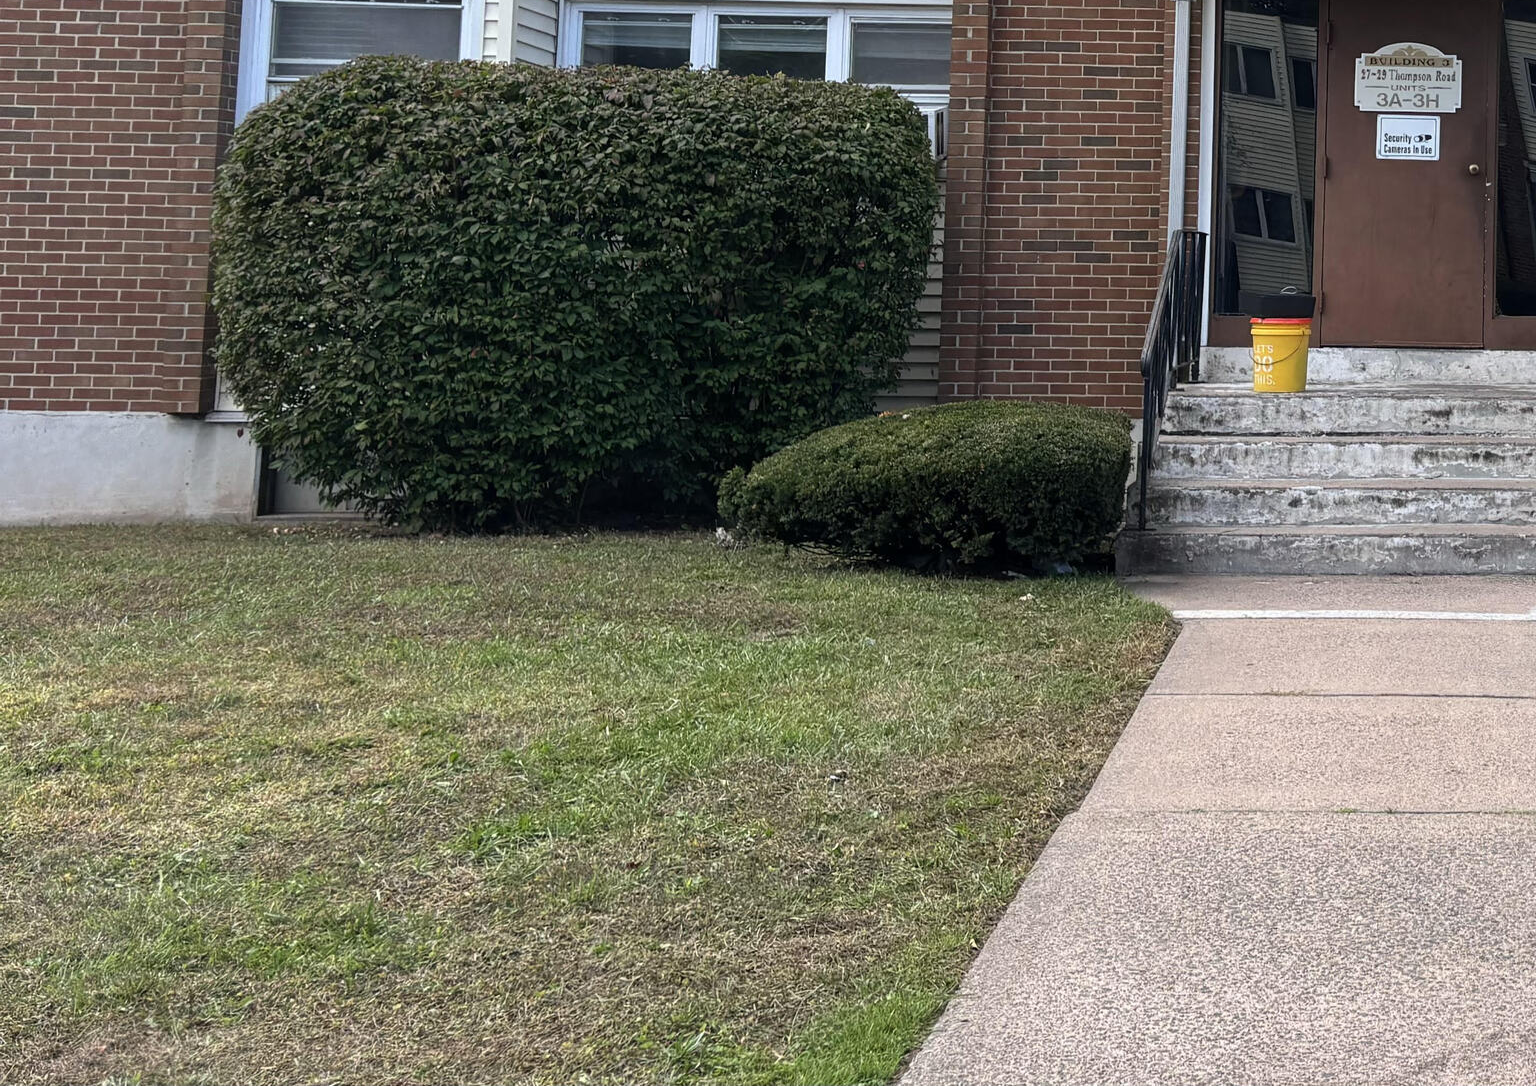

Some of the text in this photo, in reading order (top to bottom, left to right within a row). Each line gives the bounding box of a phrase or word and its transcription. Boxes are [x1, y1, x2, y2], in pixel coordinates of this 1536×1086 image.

[1370, 57, 1435, 66] BUILDING
[1388, 69, 1432, 83] Thompson
[1435, 70, 1456, 82] Road
[1390, 84, 1427, 92] UNITS
[1376, 92, 1439, 108] 3A-3H
[1384, 133, 1413, 144] Security
[1384, 144, 1433, 155] Cameras In Use
[1254, 355, 1274, 373] DO
